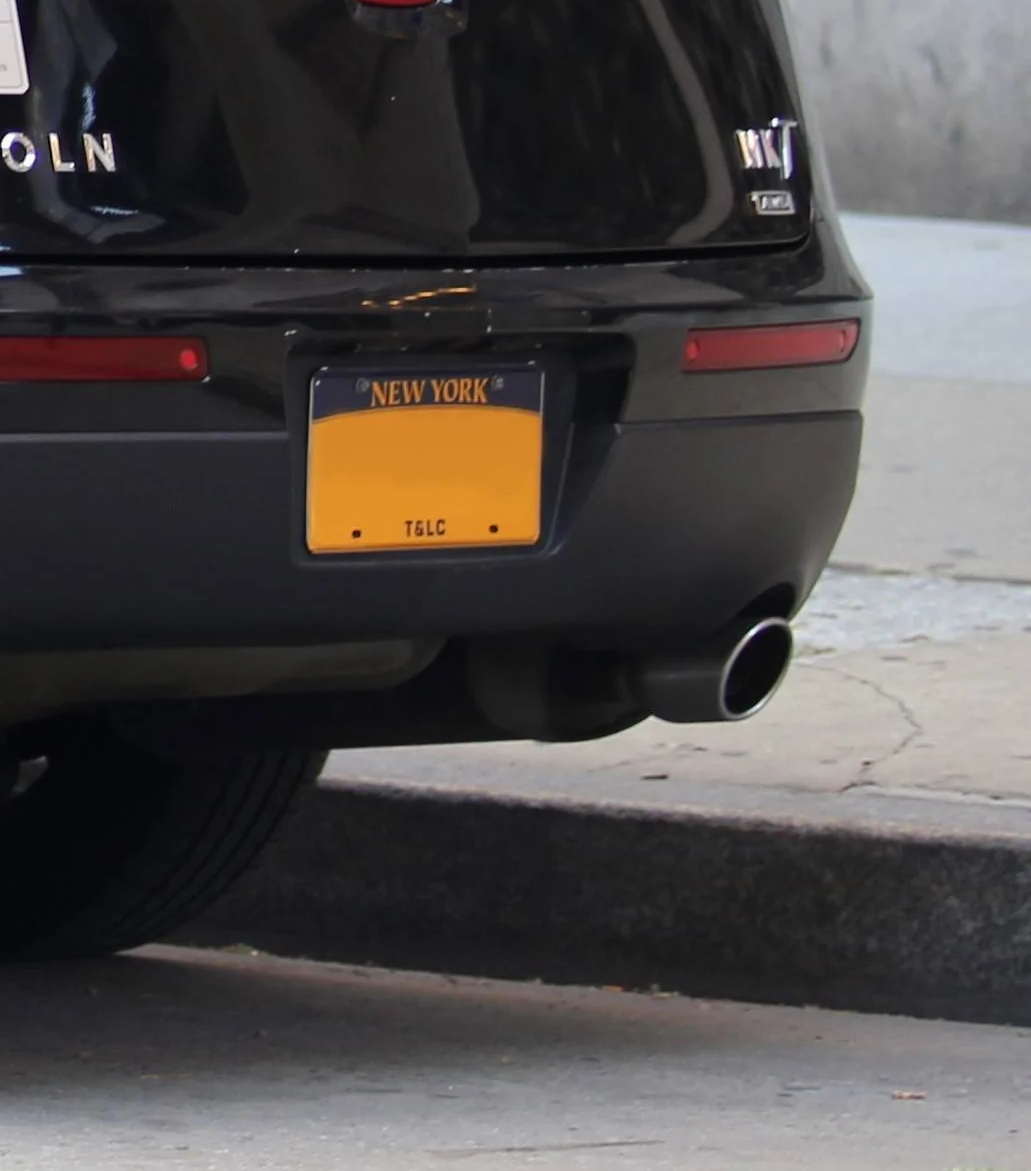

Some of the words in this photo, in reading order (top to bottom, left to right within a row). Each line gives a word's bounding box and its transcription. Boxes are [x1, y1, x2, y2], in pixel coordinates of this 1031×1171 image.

[734, 117, 798, 180] MKT
[370, 379, 426, 407] NEW
[430, 377, 488, 403] YORK
[404, 519, 446, 537] T&LC
